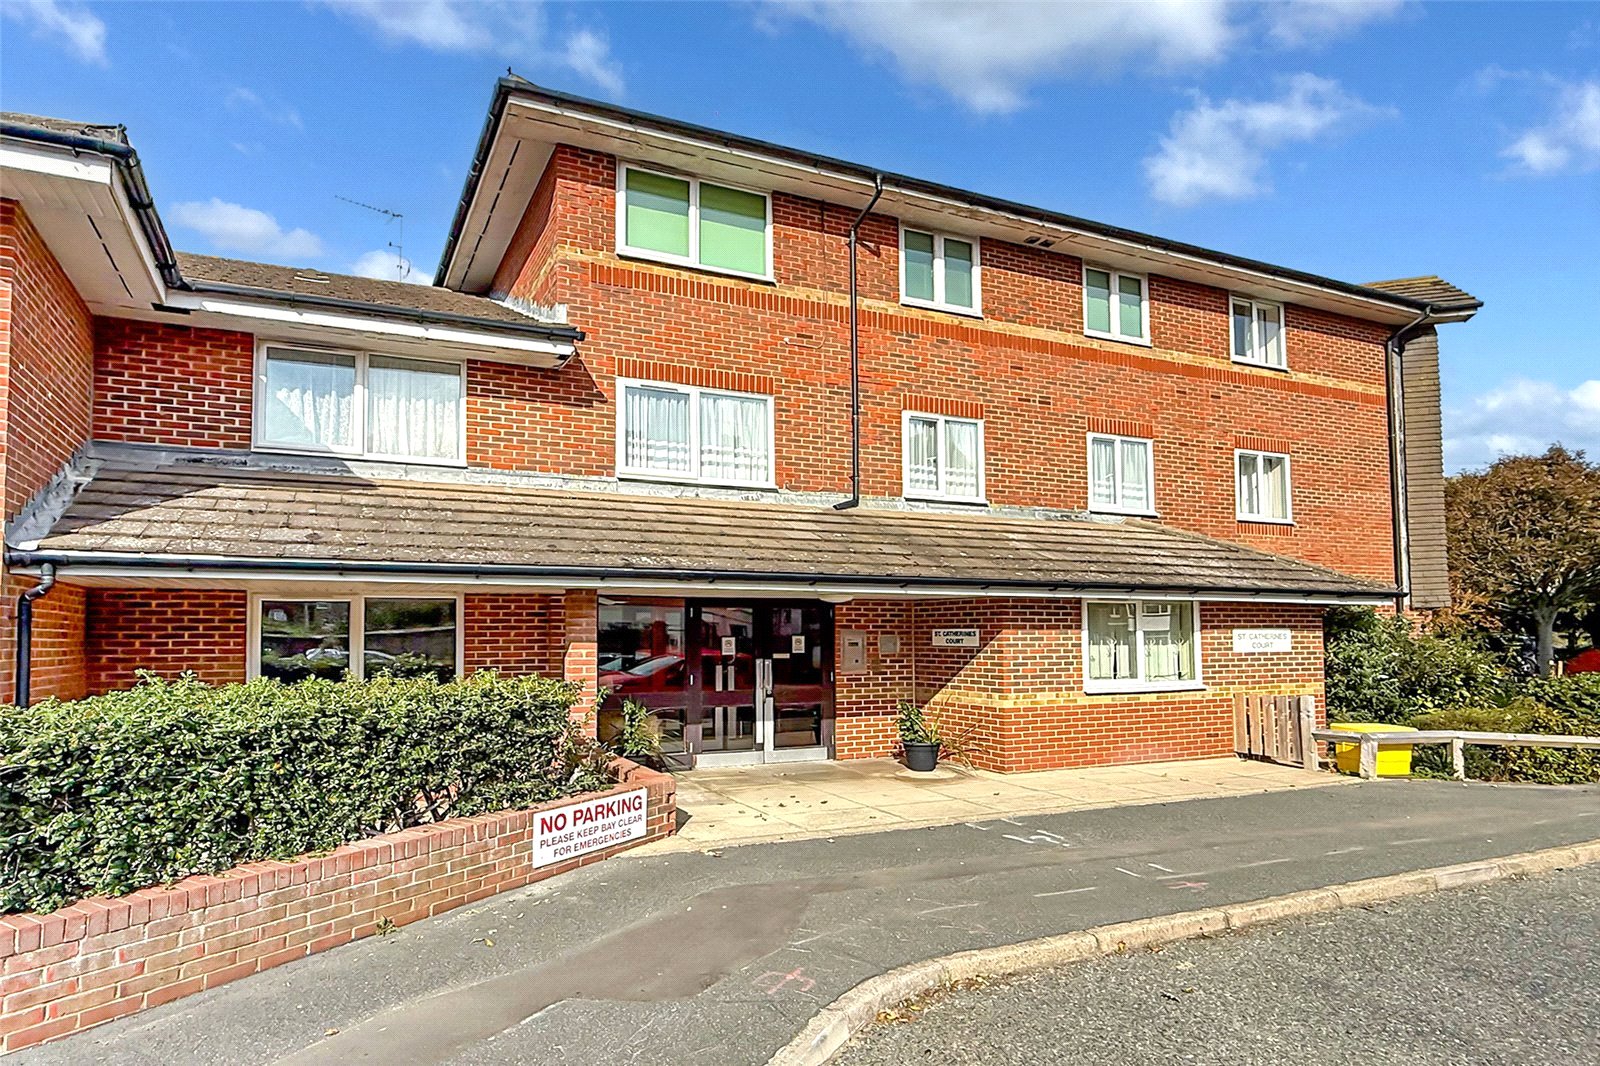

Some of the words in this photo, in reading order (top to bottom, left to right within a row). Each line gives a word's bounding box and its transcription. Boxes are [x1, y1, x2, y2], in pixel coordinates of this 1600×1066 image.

[540, 813, 567, 835] NO
[573, 795, 642, 827] PARKING
[540, 832, 574, 849] PLEASE
[576, 826, 599, 839] KEEP
[601, 820, 616, 832] BAY
[618, 814, 642, 828] CLEAR
[554, 845, 572, 858] FOR
[574, 828, 632, 852] EMERGENCIES
